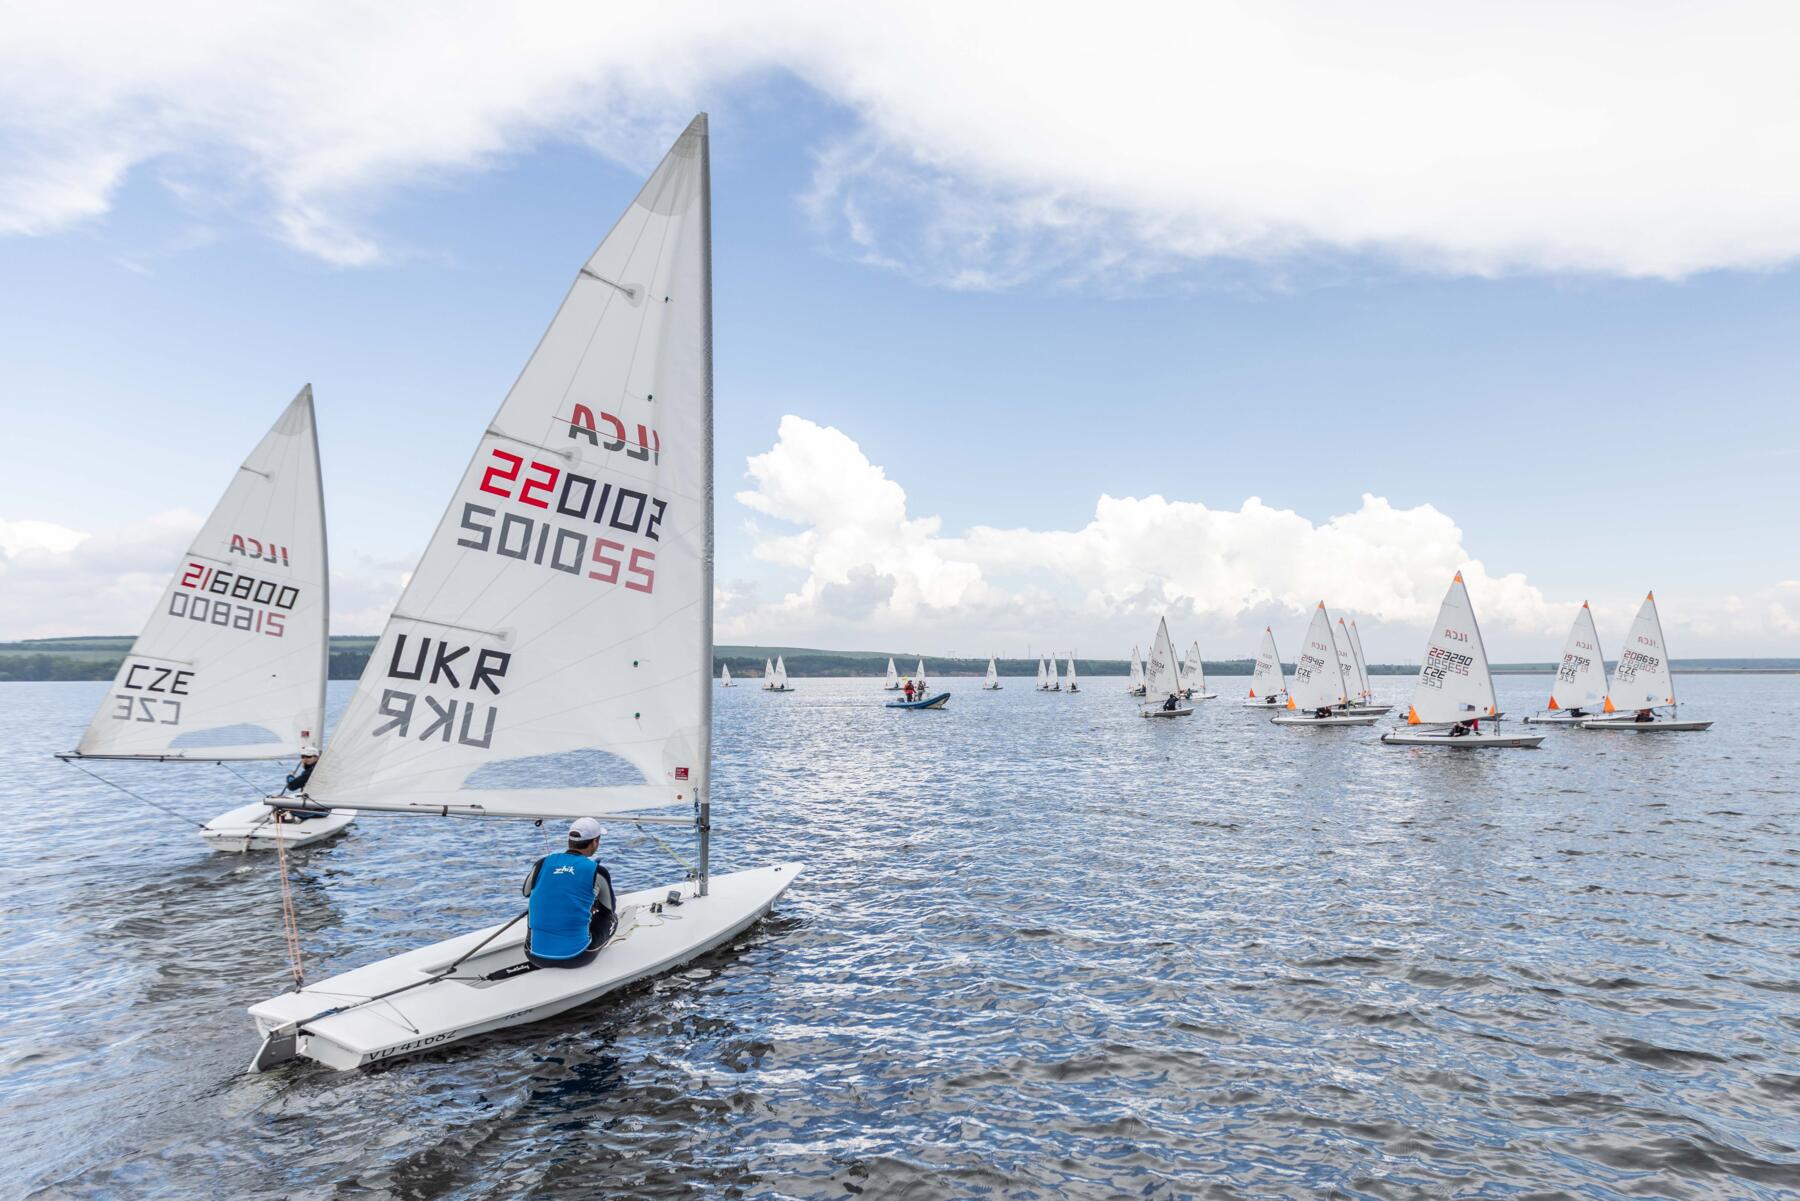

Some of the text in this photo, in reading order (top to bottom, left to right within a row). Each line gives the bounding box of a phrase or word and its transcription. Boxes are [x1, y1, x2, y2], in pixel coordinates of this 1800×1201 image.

[479, 449, 667, 542] 220102
[181, 563, 299, 610] 216800
[388, 634, 511, 695] UKR
[1429, 647, 1473, 666] 223290
[1619, 664, 1637, 677] CZE
[124, 664, 195, 695] CZE
[1424, 666, 1447, 680] CZE
